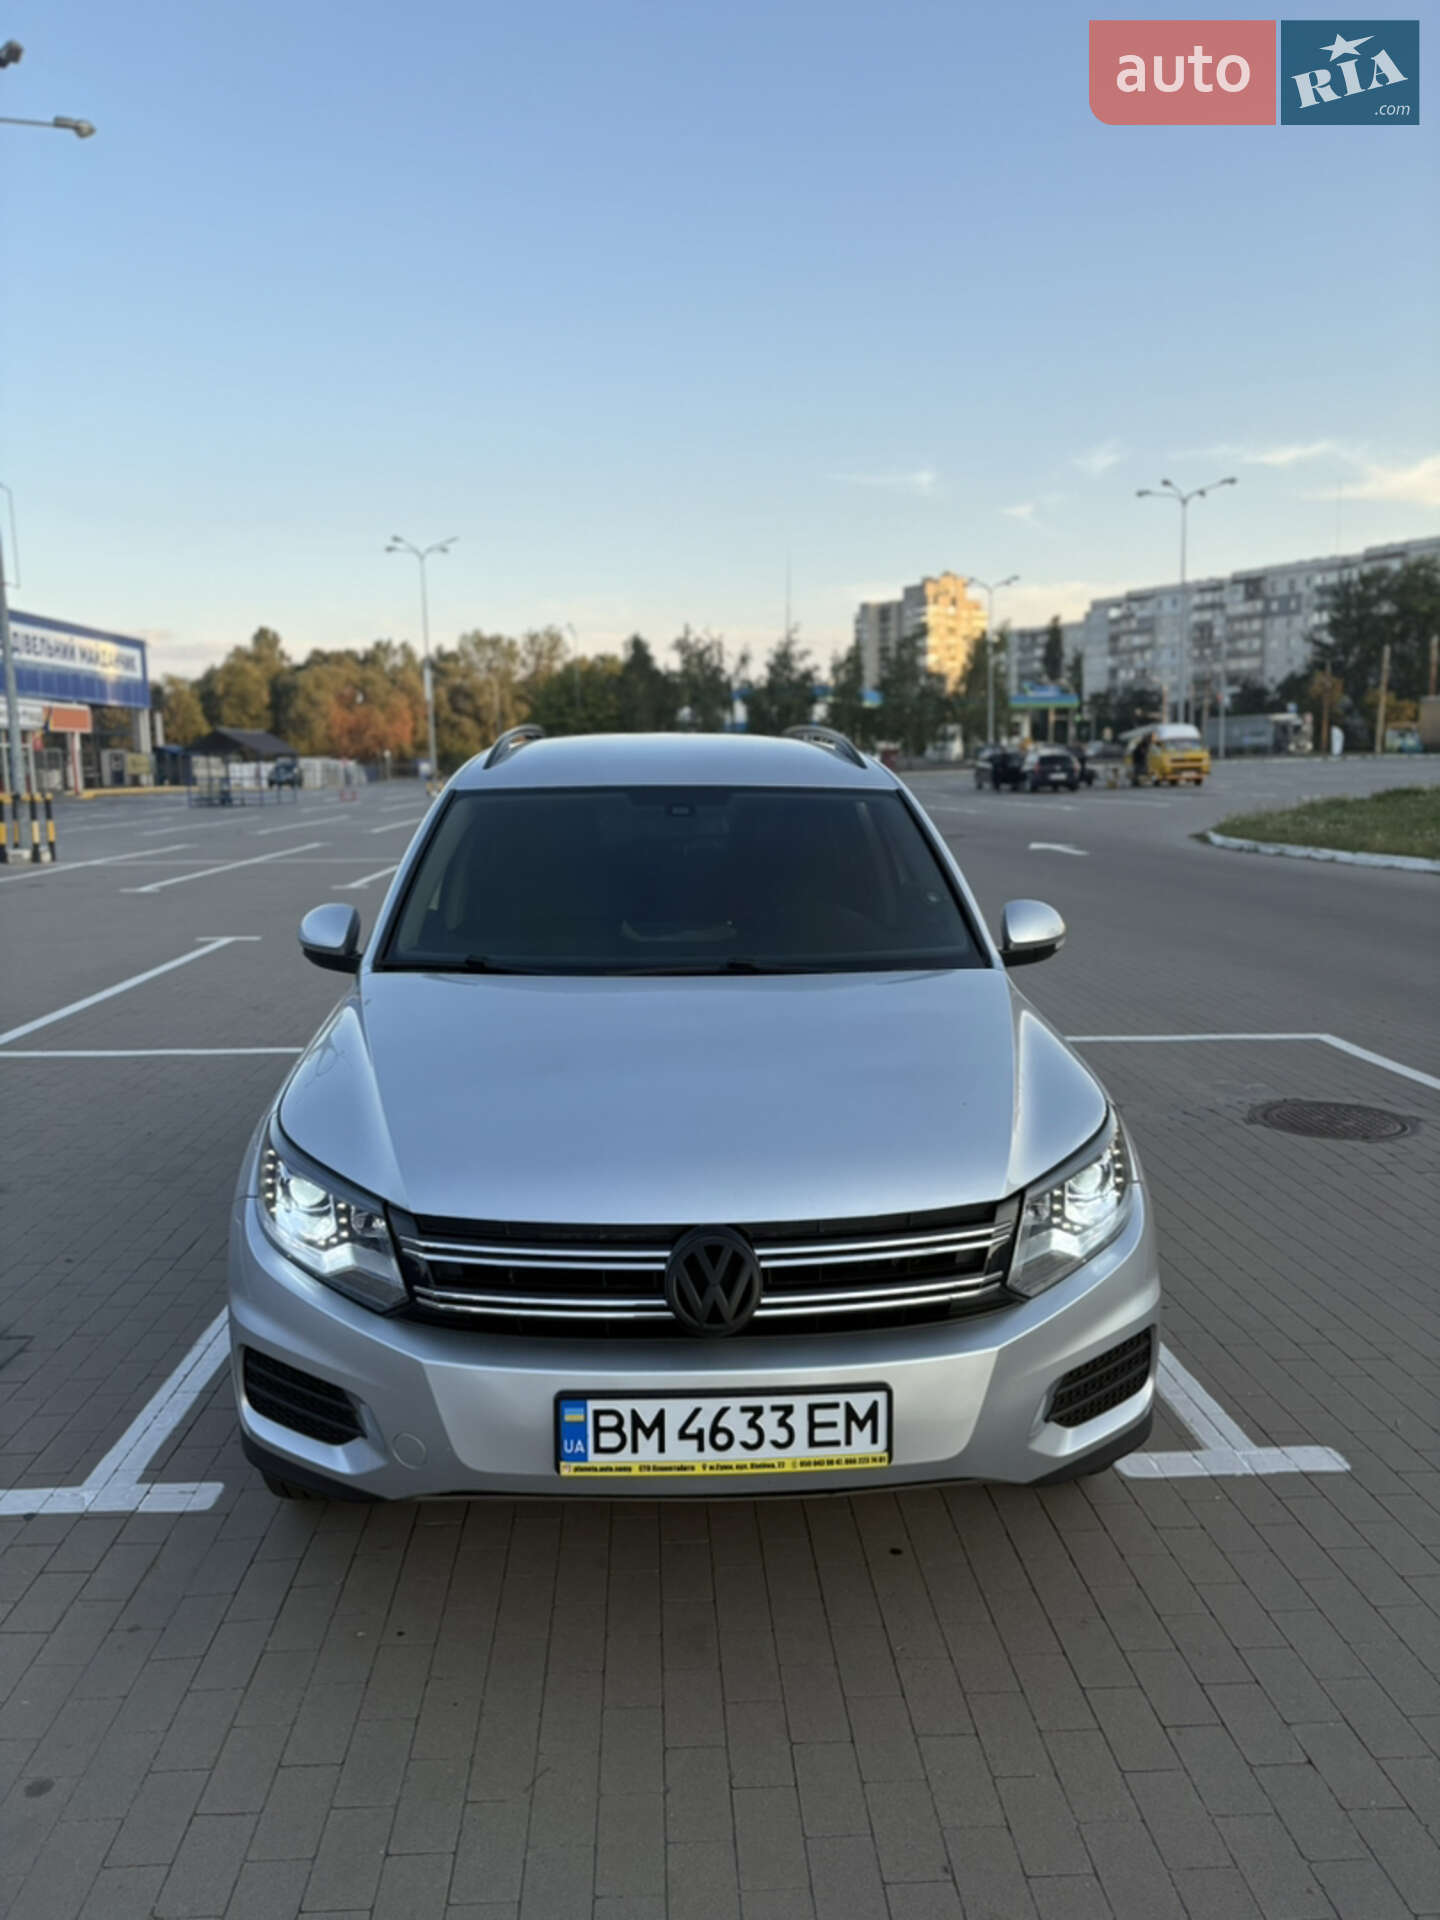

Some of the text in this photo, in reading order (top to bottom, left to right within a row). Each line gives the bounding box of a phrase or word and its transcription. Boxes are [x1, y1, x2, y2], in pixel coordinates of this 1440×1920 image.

[670, 1235, 757, 1330] VW
[563, 1438, 585, 1453] UA
[592, 1400, 879, 1454] BM 4633 EM
